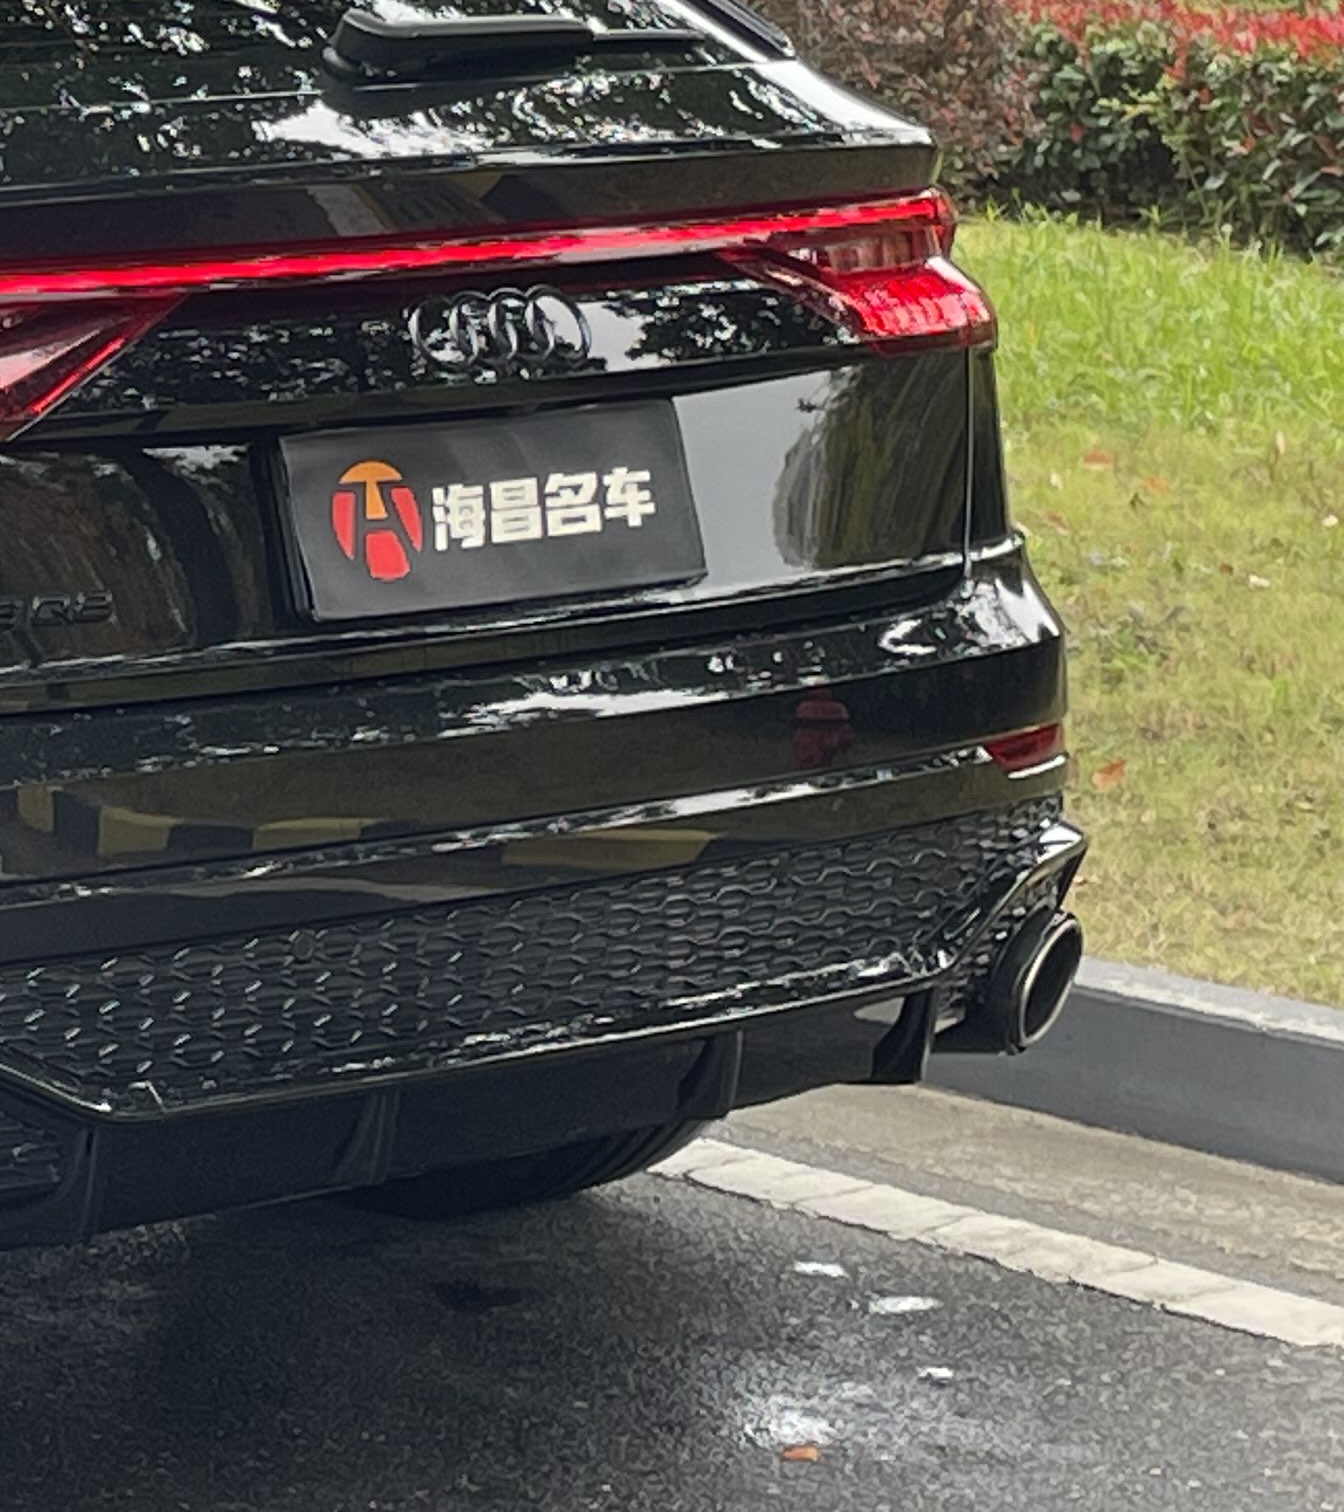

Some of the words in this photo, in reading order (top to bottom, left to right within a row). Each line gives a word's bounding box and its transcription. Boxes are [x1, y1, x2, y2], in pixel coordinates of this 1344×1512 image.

[432, 466, 657, 553] 海昌名车
[31, 589, 114, 627] Q8
